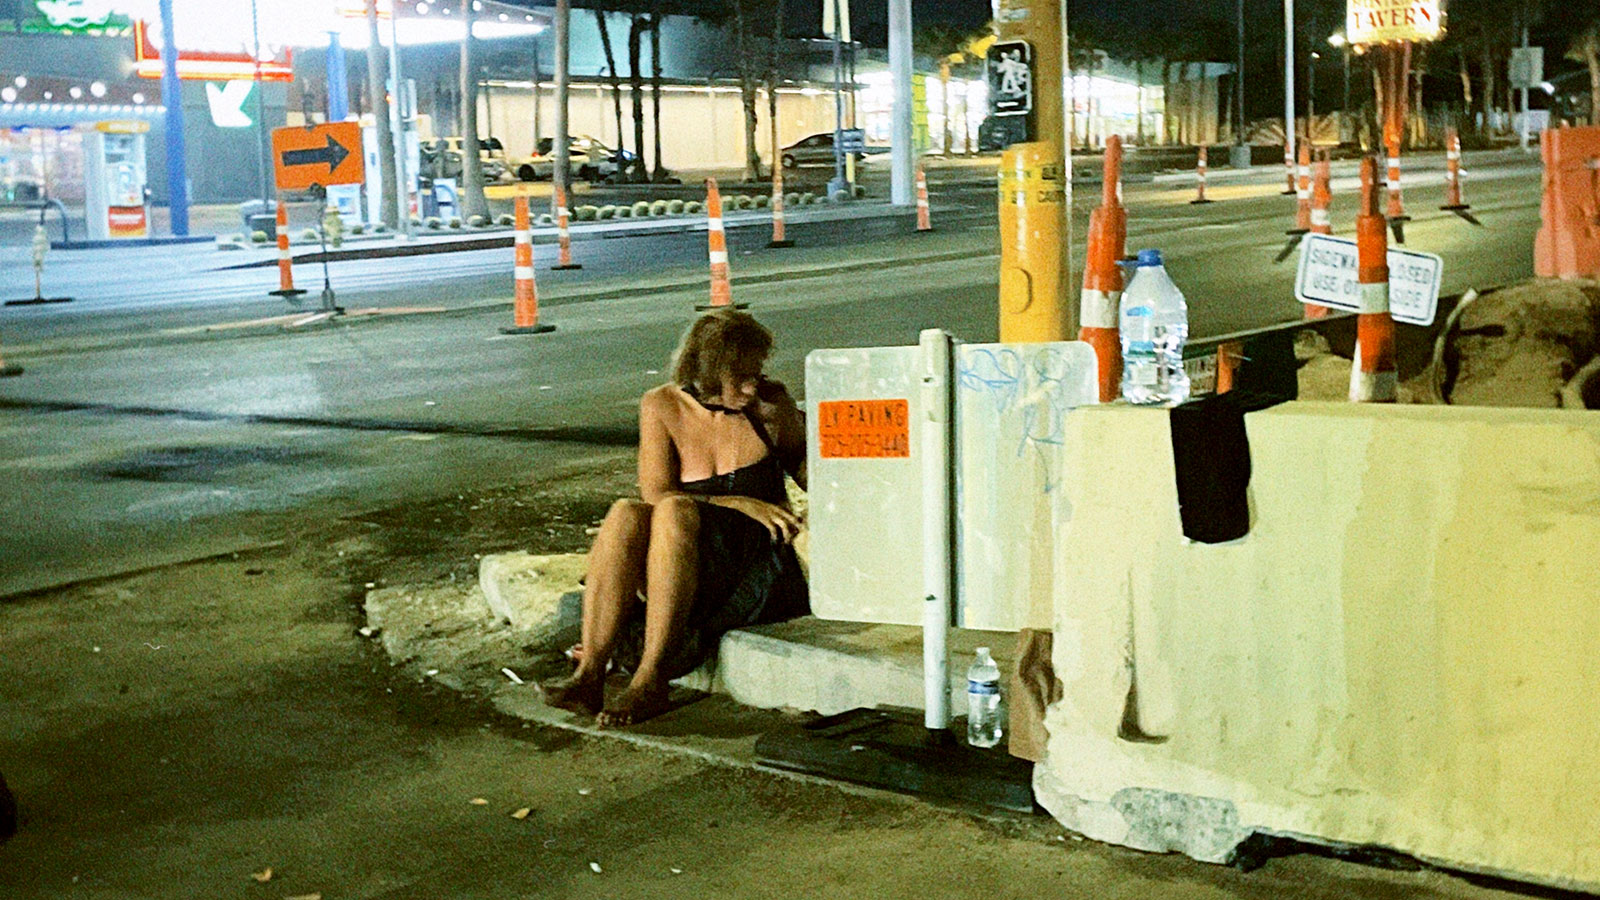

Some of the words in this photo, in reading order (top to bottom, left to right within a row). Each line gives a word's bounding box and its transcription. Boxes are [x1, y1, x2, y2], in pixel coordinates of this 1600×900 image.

[1353, 7, 1432, 29] TAVERN
[1309, 246, 1357, 269] SIDEWA
[848, 402, 905, 427] PAVING
